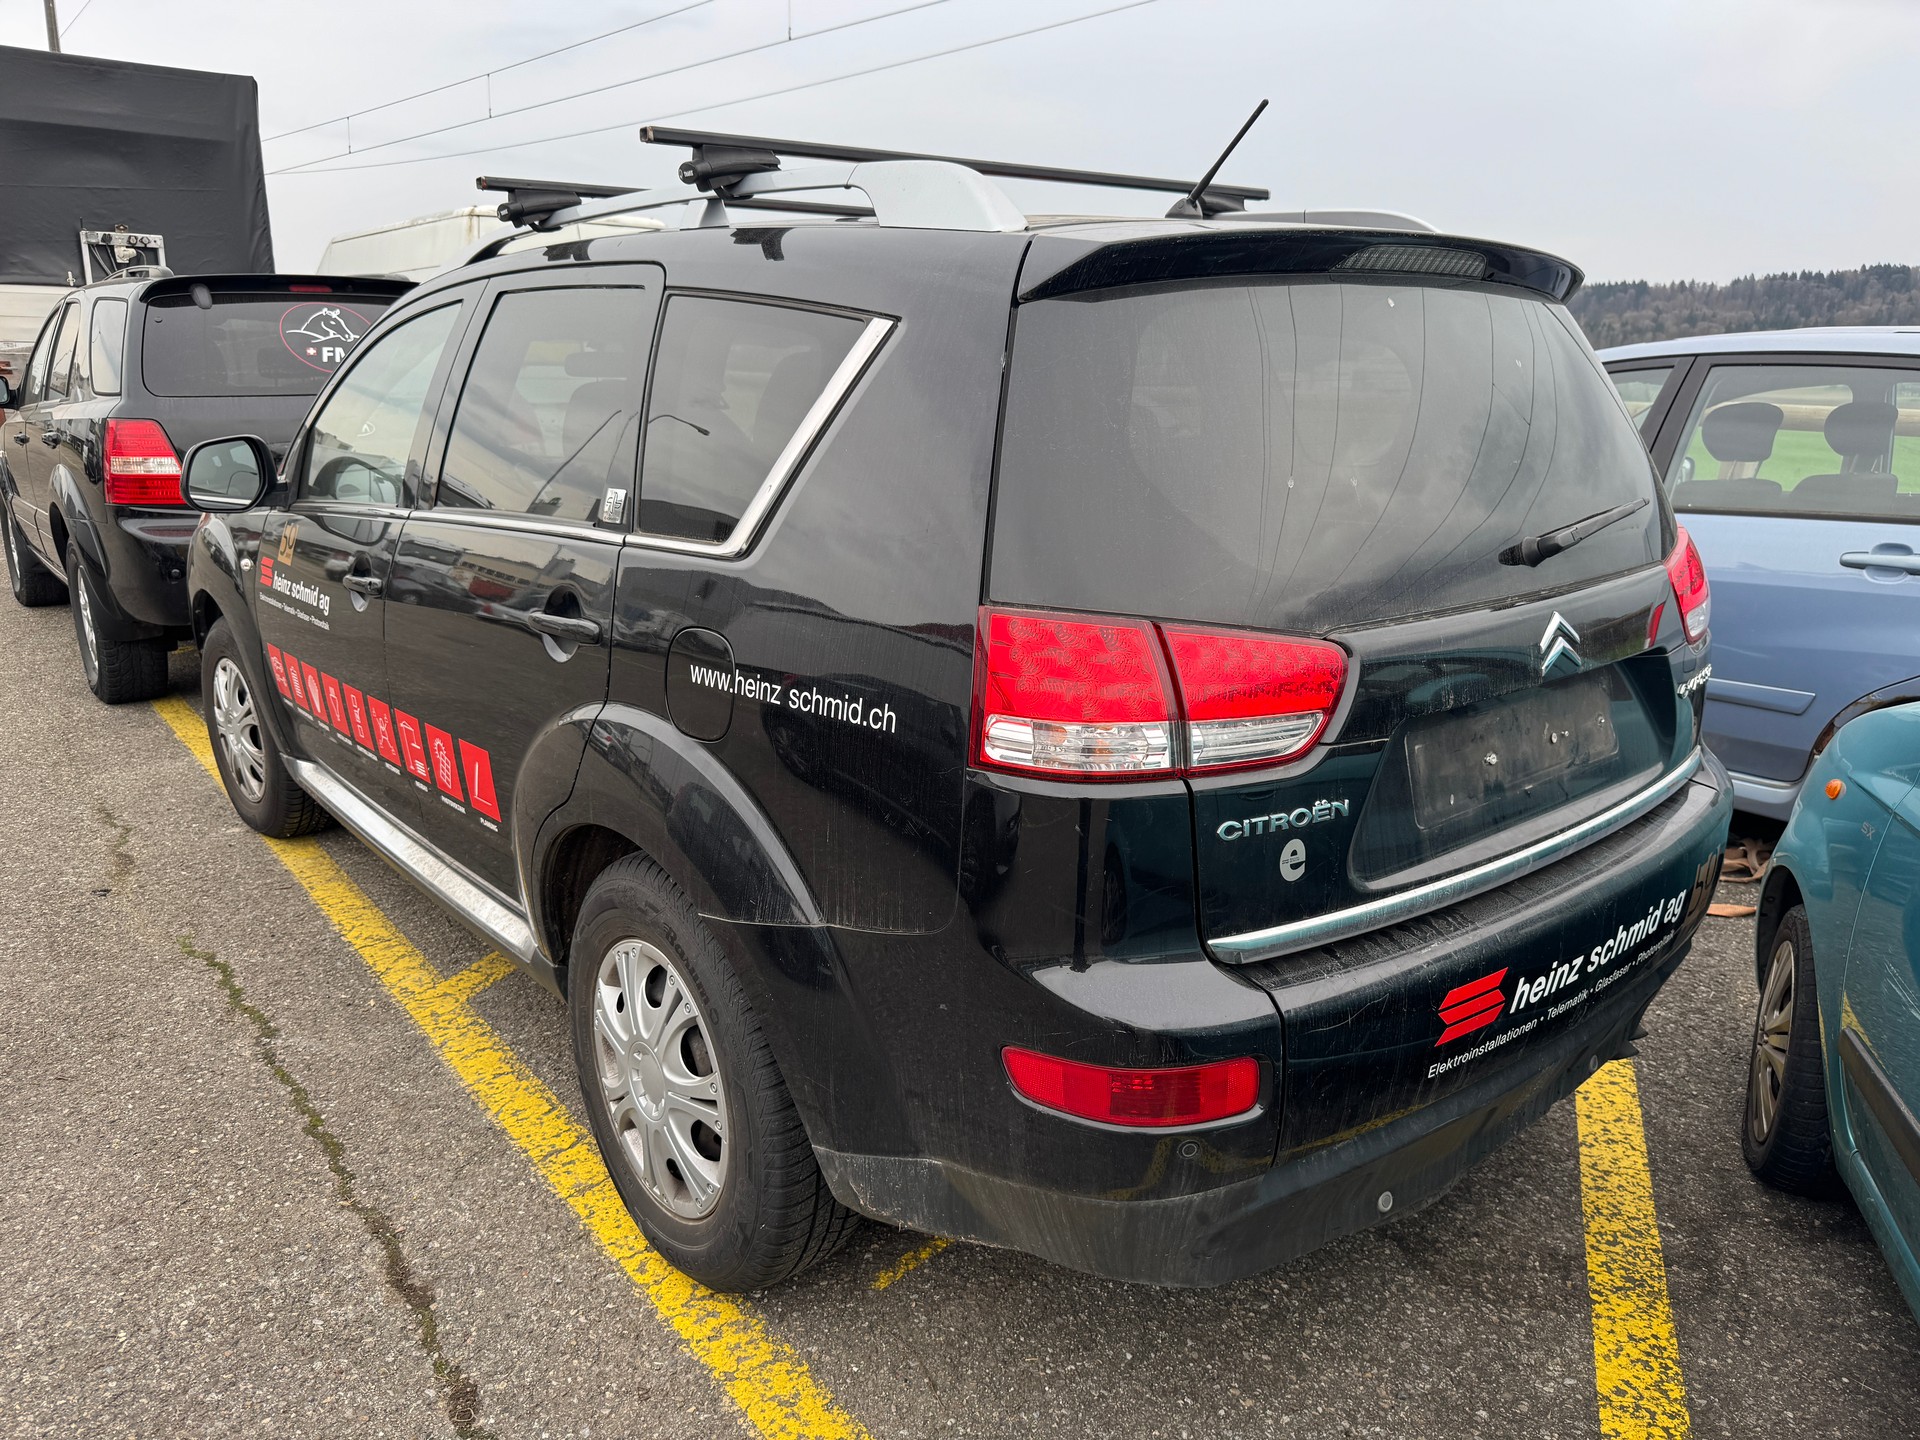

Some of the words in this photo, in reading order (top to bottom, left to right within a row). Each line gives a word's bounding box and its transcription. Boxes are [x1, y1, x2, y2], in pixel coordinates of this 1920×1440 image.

[272, 571, 291, 596] heinz
[291, 581, 319, 607] schmid
[319, 594, 330, 616] ag
[690, 664, 781, 705] www.heinz
[789, 687, 896, 733] schmid.ch
[1216, 799, 1349, 841] CITROËN
[1509, 955, 1584, 1014] heinz
[1587, 898, 1664, 973] schmid
[1664, 889, 1686, 923] ag
[1428, 1018, 1538, 1078] Elektroinstallationen
[1547, 989, 1588, 1020] Telematik
[1595, 962, 1631, 993] Glasfaser
